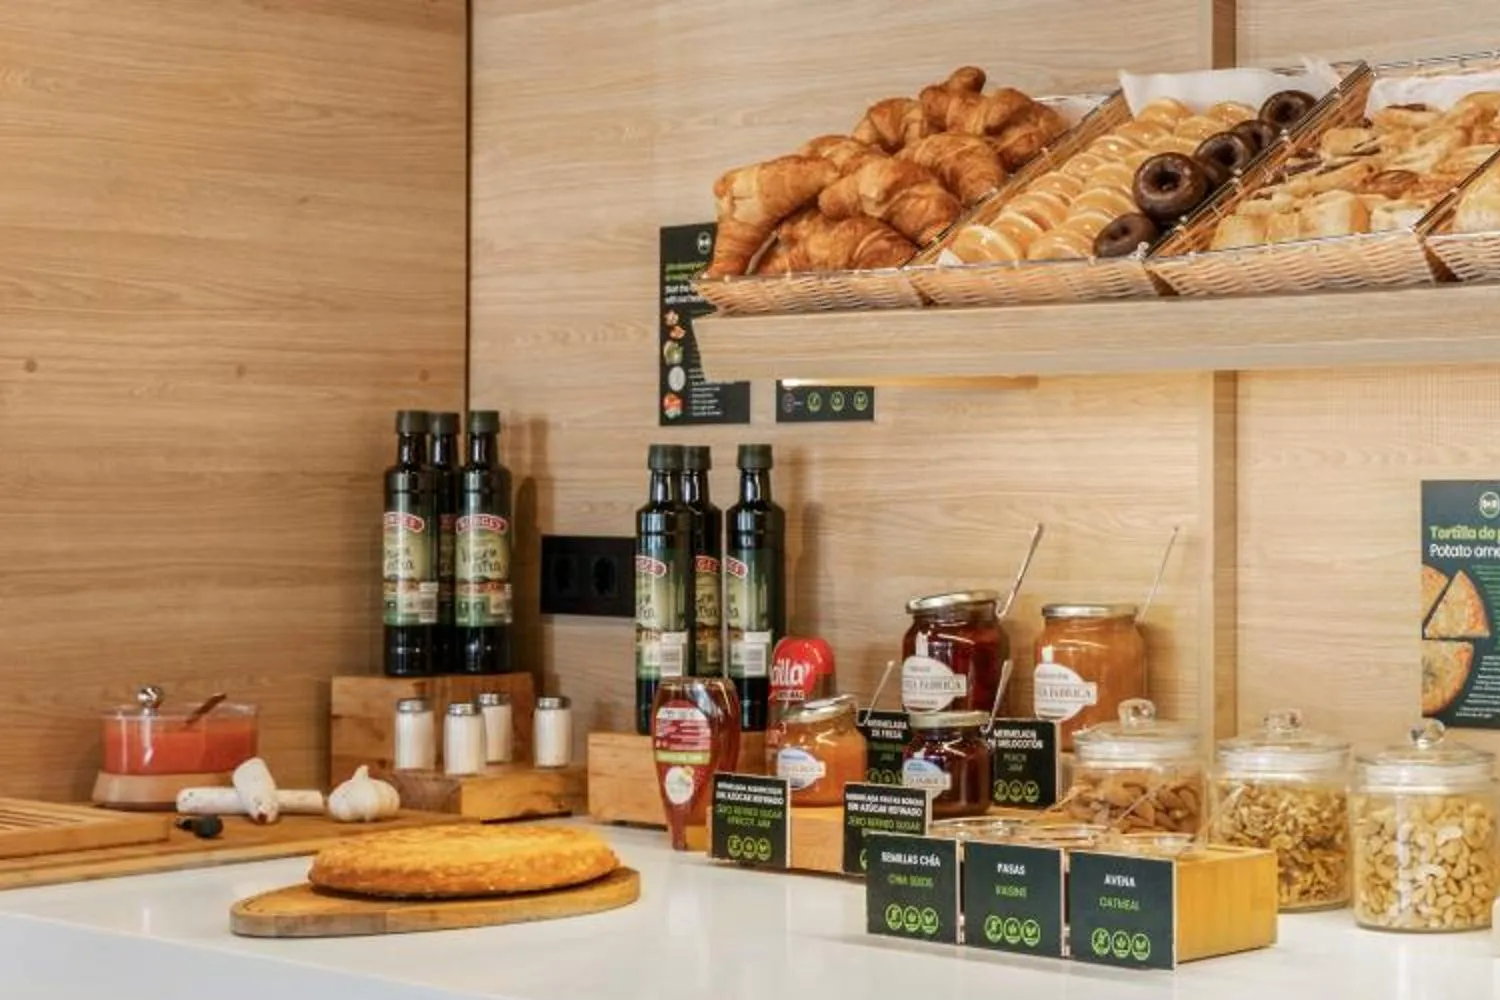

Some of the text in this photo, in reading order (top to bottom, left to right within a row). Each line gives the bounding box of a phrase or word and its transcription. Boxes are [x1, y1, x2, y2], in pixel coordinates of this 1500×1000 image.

[1429, 524, 1477, 540] Tortilla
[1478, 525, 1496, 540] de
[1429, 543, 1473, 558] Potato
[881, 851, 919, 865] SEMILLAS
[997, 863, 1026, 876] PASAS
[1104, 873, 1136, 888] AVENA
